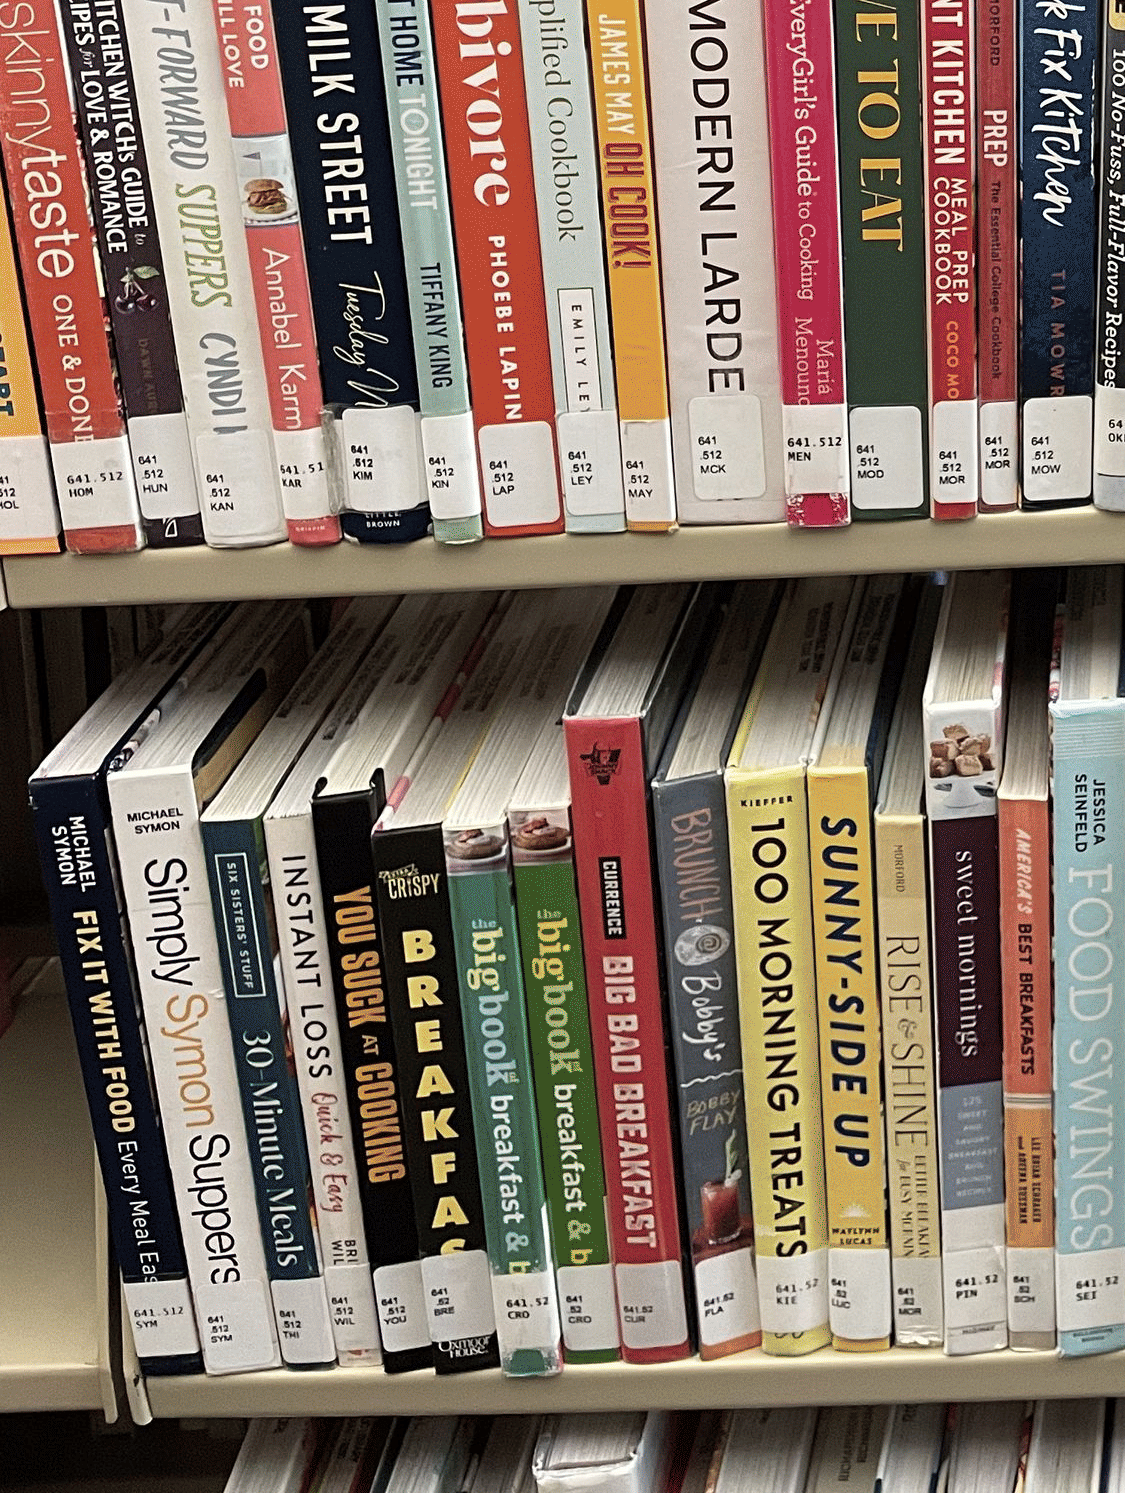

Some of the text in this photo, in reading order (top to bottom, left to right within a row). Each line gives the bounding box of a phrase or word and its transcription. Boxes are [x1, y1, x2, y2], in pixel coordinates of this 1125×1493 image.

[222, 32, 245, 90] LOVE
[243, 5, 270, 71] FOOD
[393, 12, 426, 87] HOME
[302, 4, 373, 245] MILK STREET
[856, 59, 901, 138] TO
[932, 39, 966, 166] KITCHEN
[546, 96, 585, 242] Cookbook
[859, 158, 902, 251] EAT
[488, 235, 516, 333] PHOEBE
[498, 344, 523, 420] LAPIN
[787, 437, 842, 448] 641.512
[788, 451, 811, 462] MEN
[127, 808, 183, 823] MICHAEL
[135, 821, 180, 834] SYMON
[1074, 774, 1088, 853] SEINFELD
[1091, 779, 1106, 846] JESSICA
[52, 826, 76, 885] SYMON
[69, 816, 96, 893] MICHAEL
[600, 859, 623, 935] CURRENCE
[144, 857, 215, 1128] Simply Symon
[282, 856, 332, 1079] INSTANT LOSS
[751, 818, 798, 1112] 100 MORNING
[820, 816, 870, 1166] SUNNY-SIDE UP
[955, 850, 979, 1057] sweet mornings
[603, 956, 656, 1248] BIG BAD BREAKFAST
